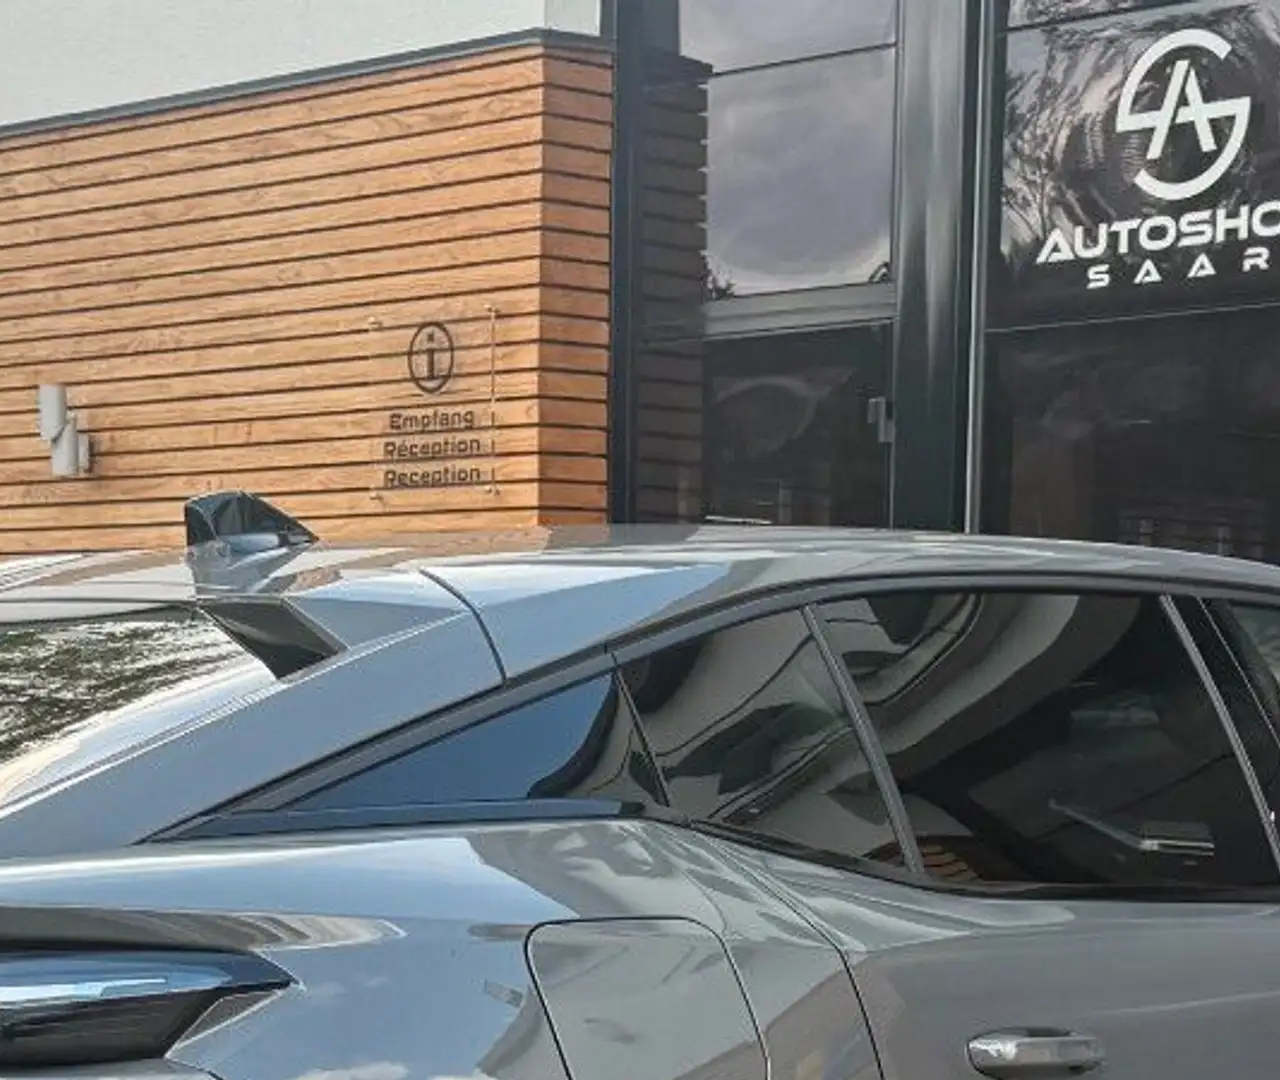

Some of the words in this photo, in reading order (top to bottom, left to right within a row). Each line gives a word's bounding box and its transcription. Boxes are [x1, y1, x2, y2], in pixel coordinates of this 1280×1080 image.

[1086, 247, 1270, 288] SAAR
[389, 410, 475, 430] Empfang
[384, 438, 480, 459] Réception
[384, 465, 480, 488] Reception
